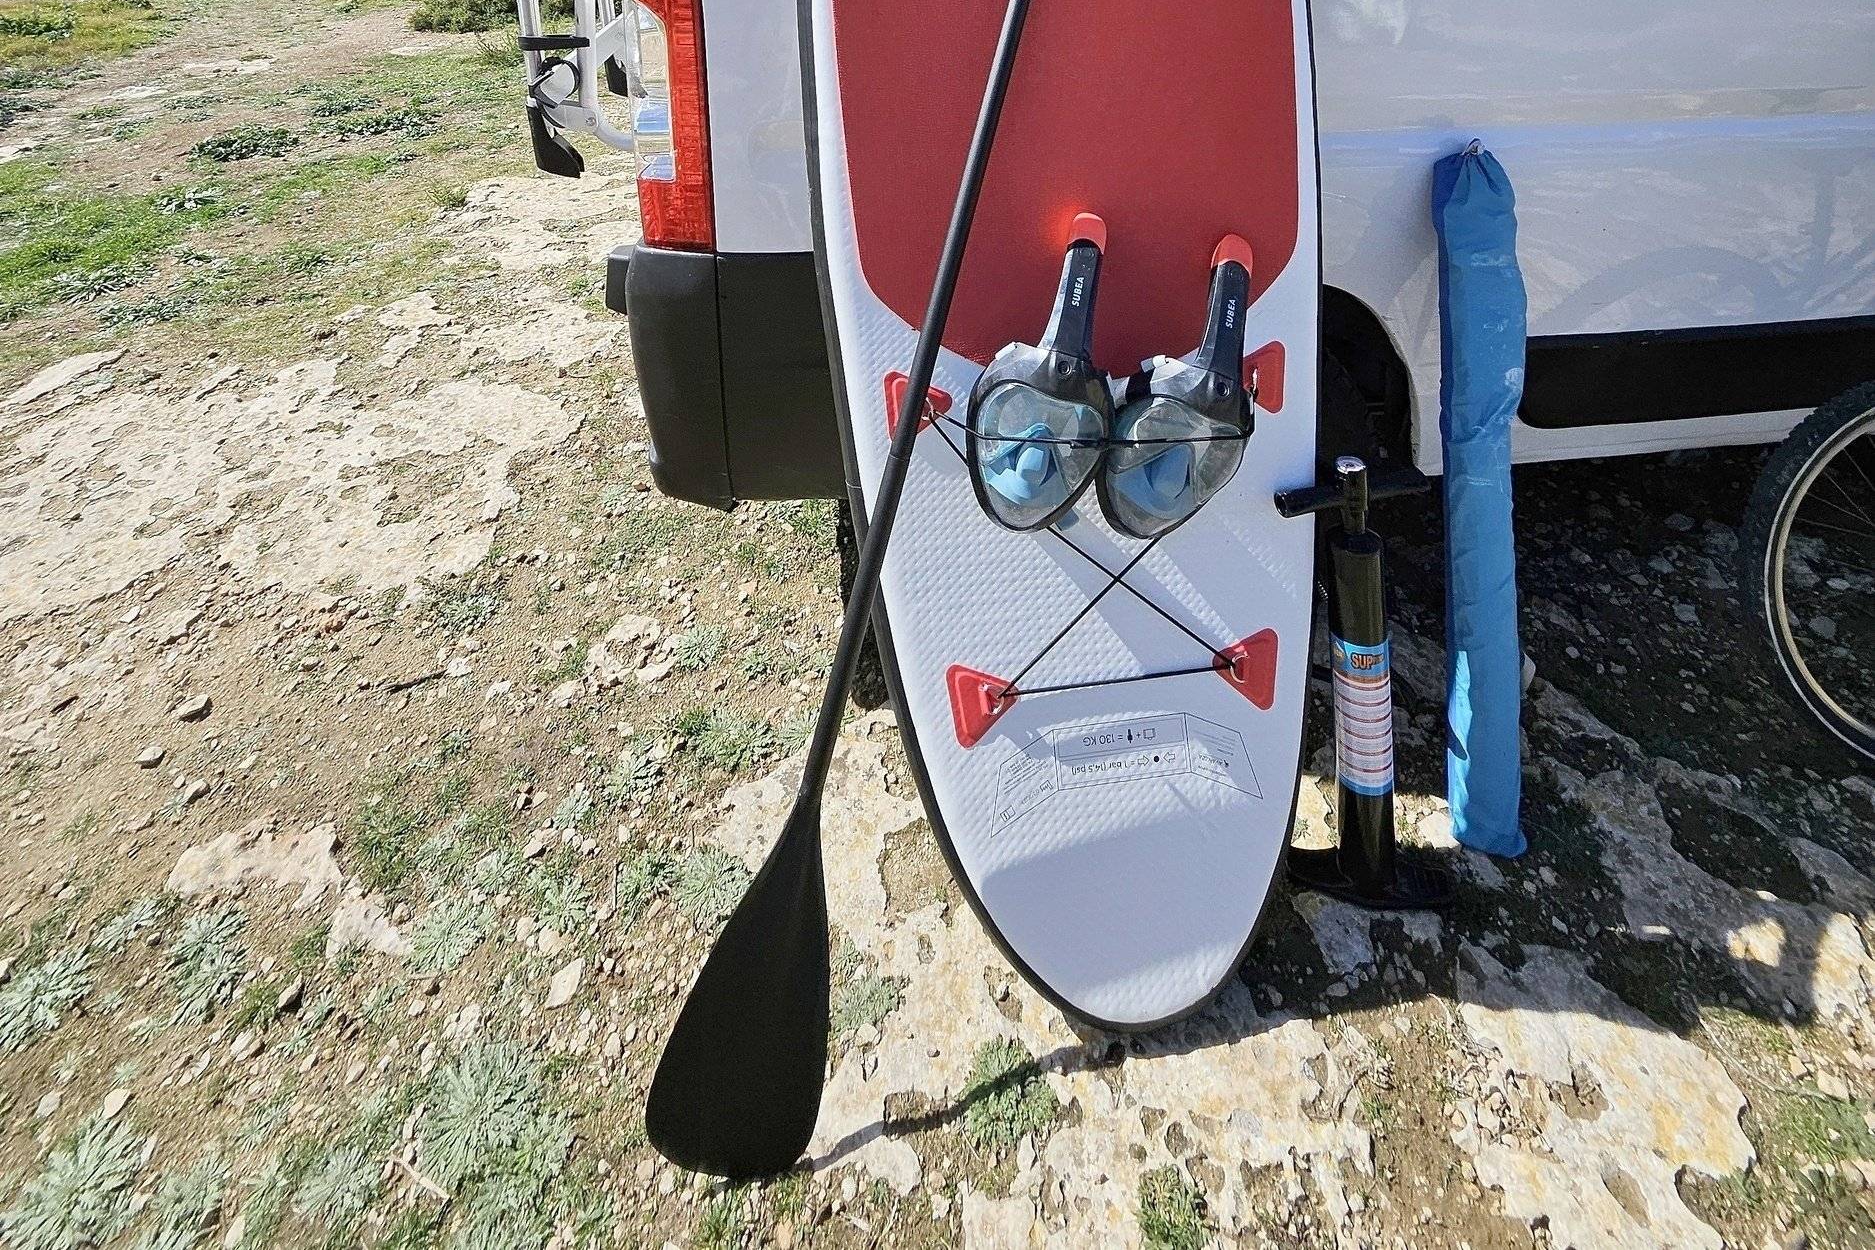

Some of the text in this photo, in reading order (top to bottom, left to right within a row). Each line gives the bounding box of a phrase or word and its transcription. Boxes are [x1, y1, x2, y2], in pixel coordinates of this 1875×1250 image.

[1071, 277, 1084, 306] SUBEA
[1225, 299, 1236, 329] SUBEA
[1083, 737, 1096, 746] KG
[1099, 734, 1115, 744] 130
[1109, 761, 1121, 770] bar
